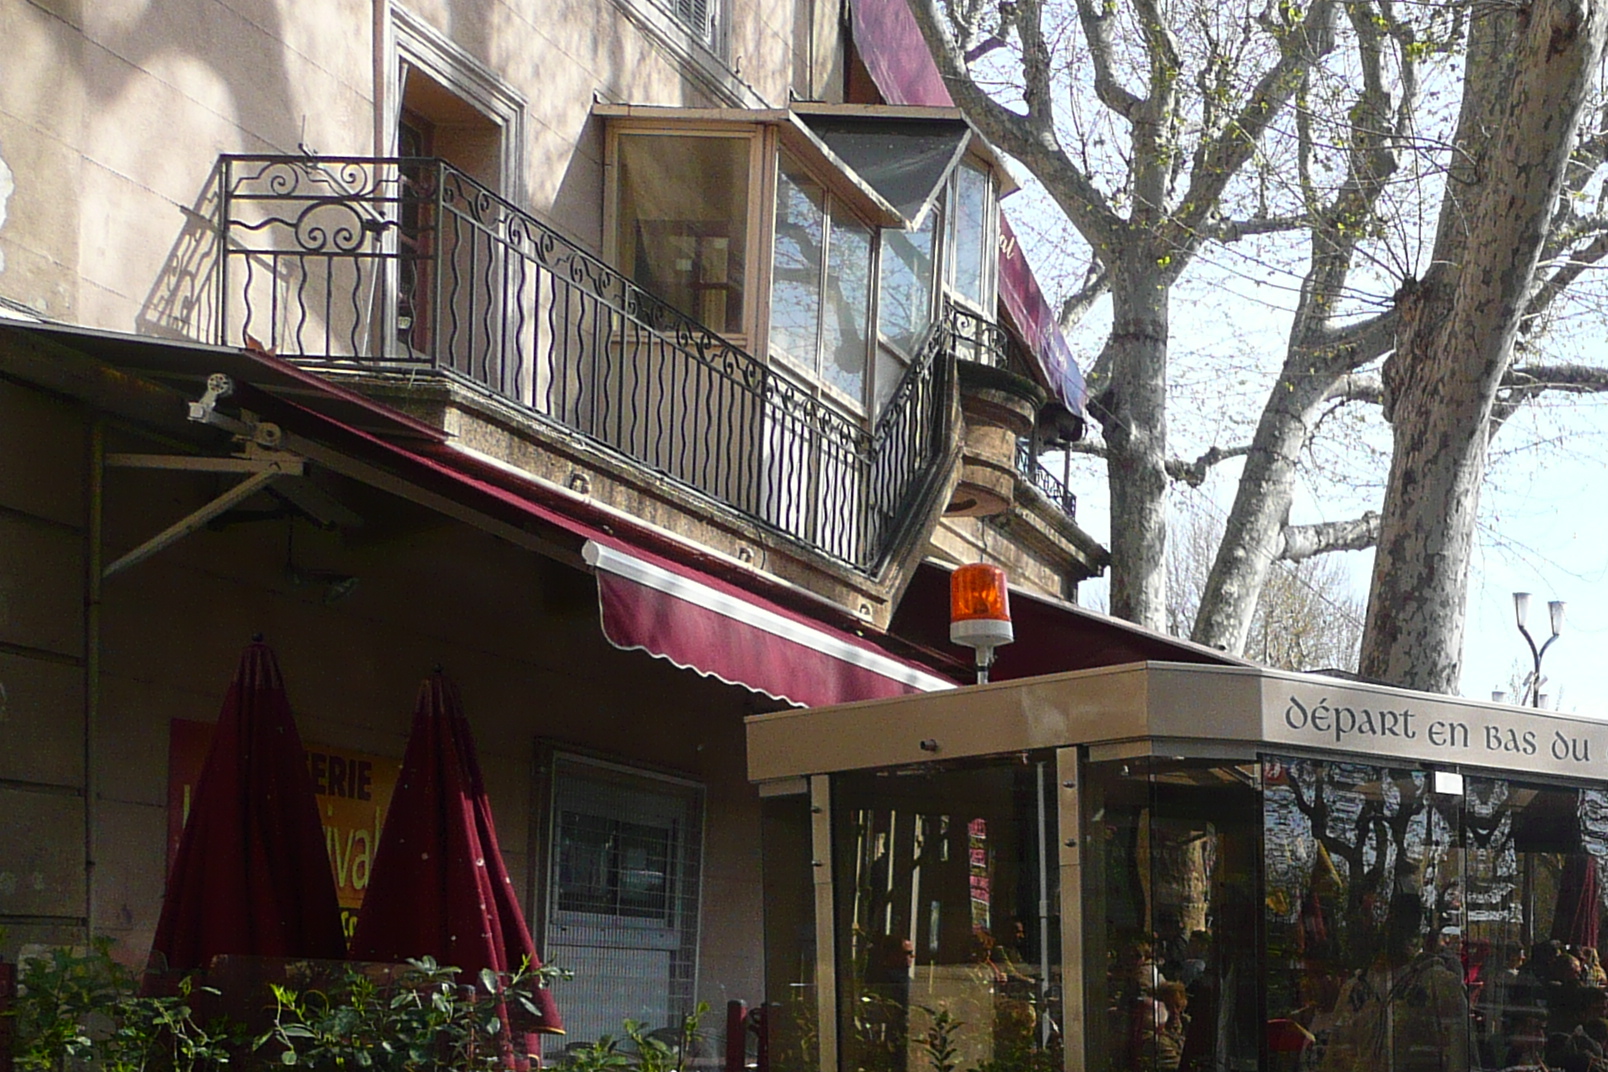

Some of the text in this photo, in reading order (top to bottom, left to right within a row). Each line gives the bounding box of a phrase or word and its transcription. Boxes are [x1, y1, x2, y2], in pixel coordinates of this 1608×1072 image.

[1284, 695, 1416, 742] départ
[1427, 720, 1470, 748] en
[1551, 730, 1590, 762] du
[305, 751, 373, 801] ERIE
